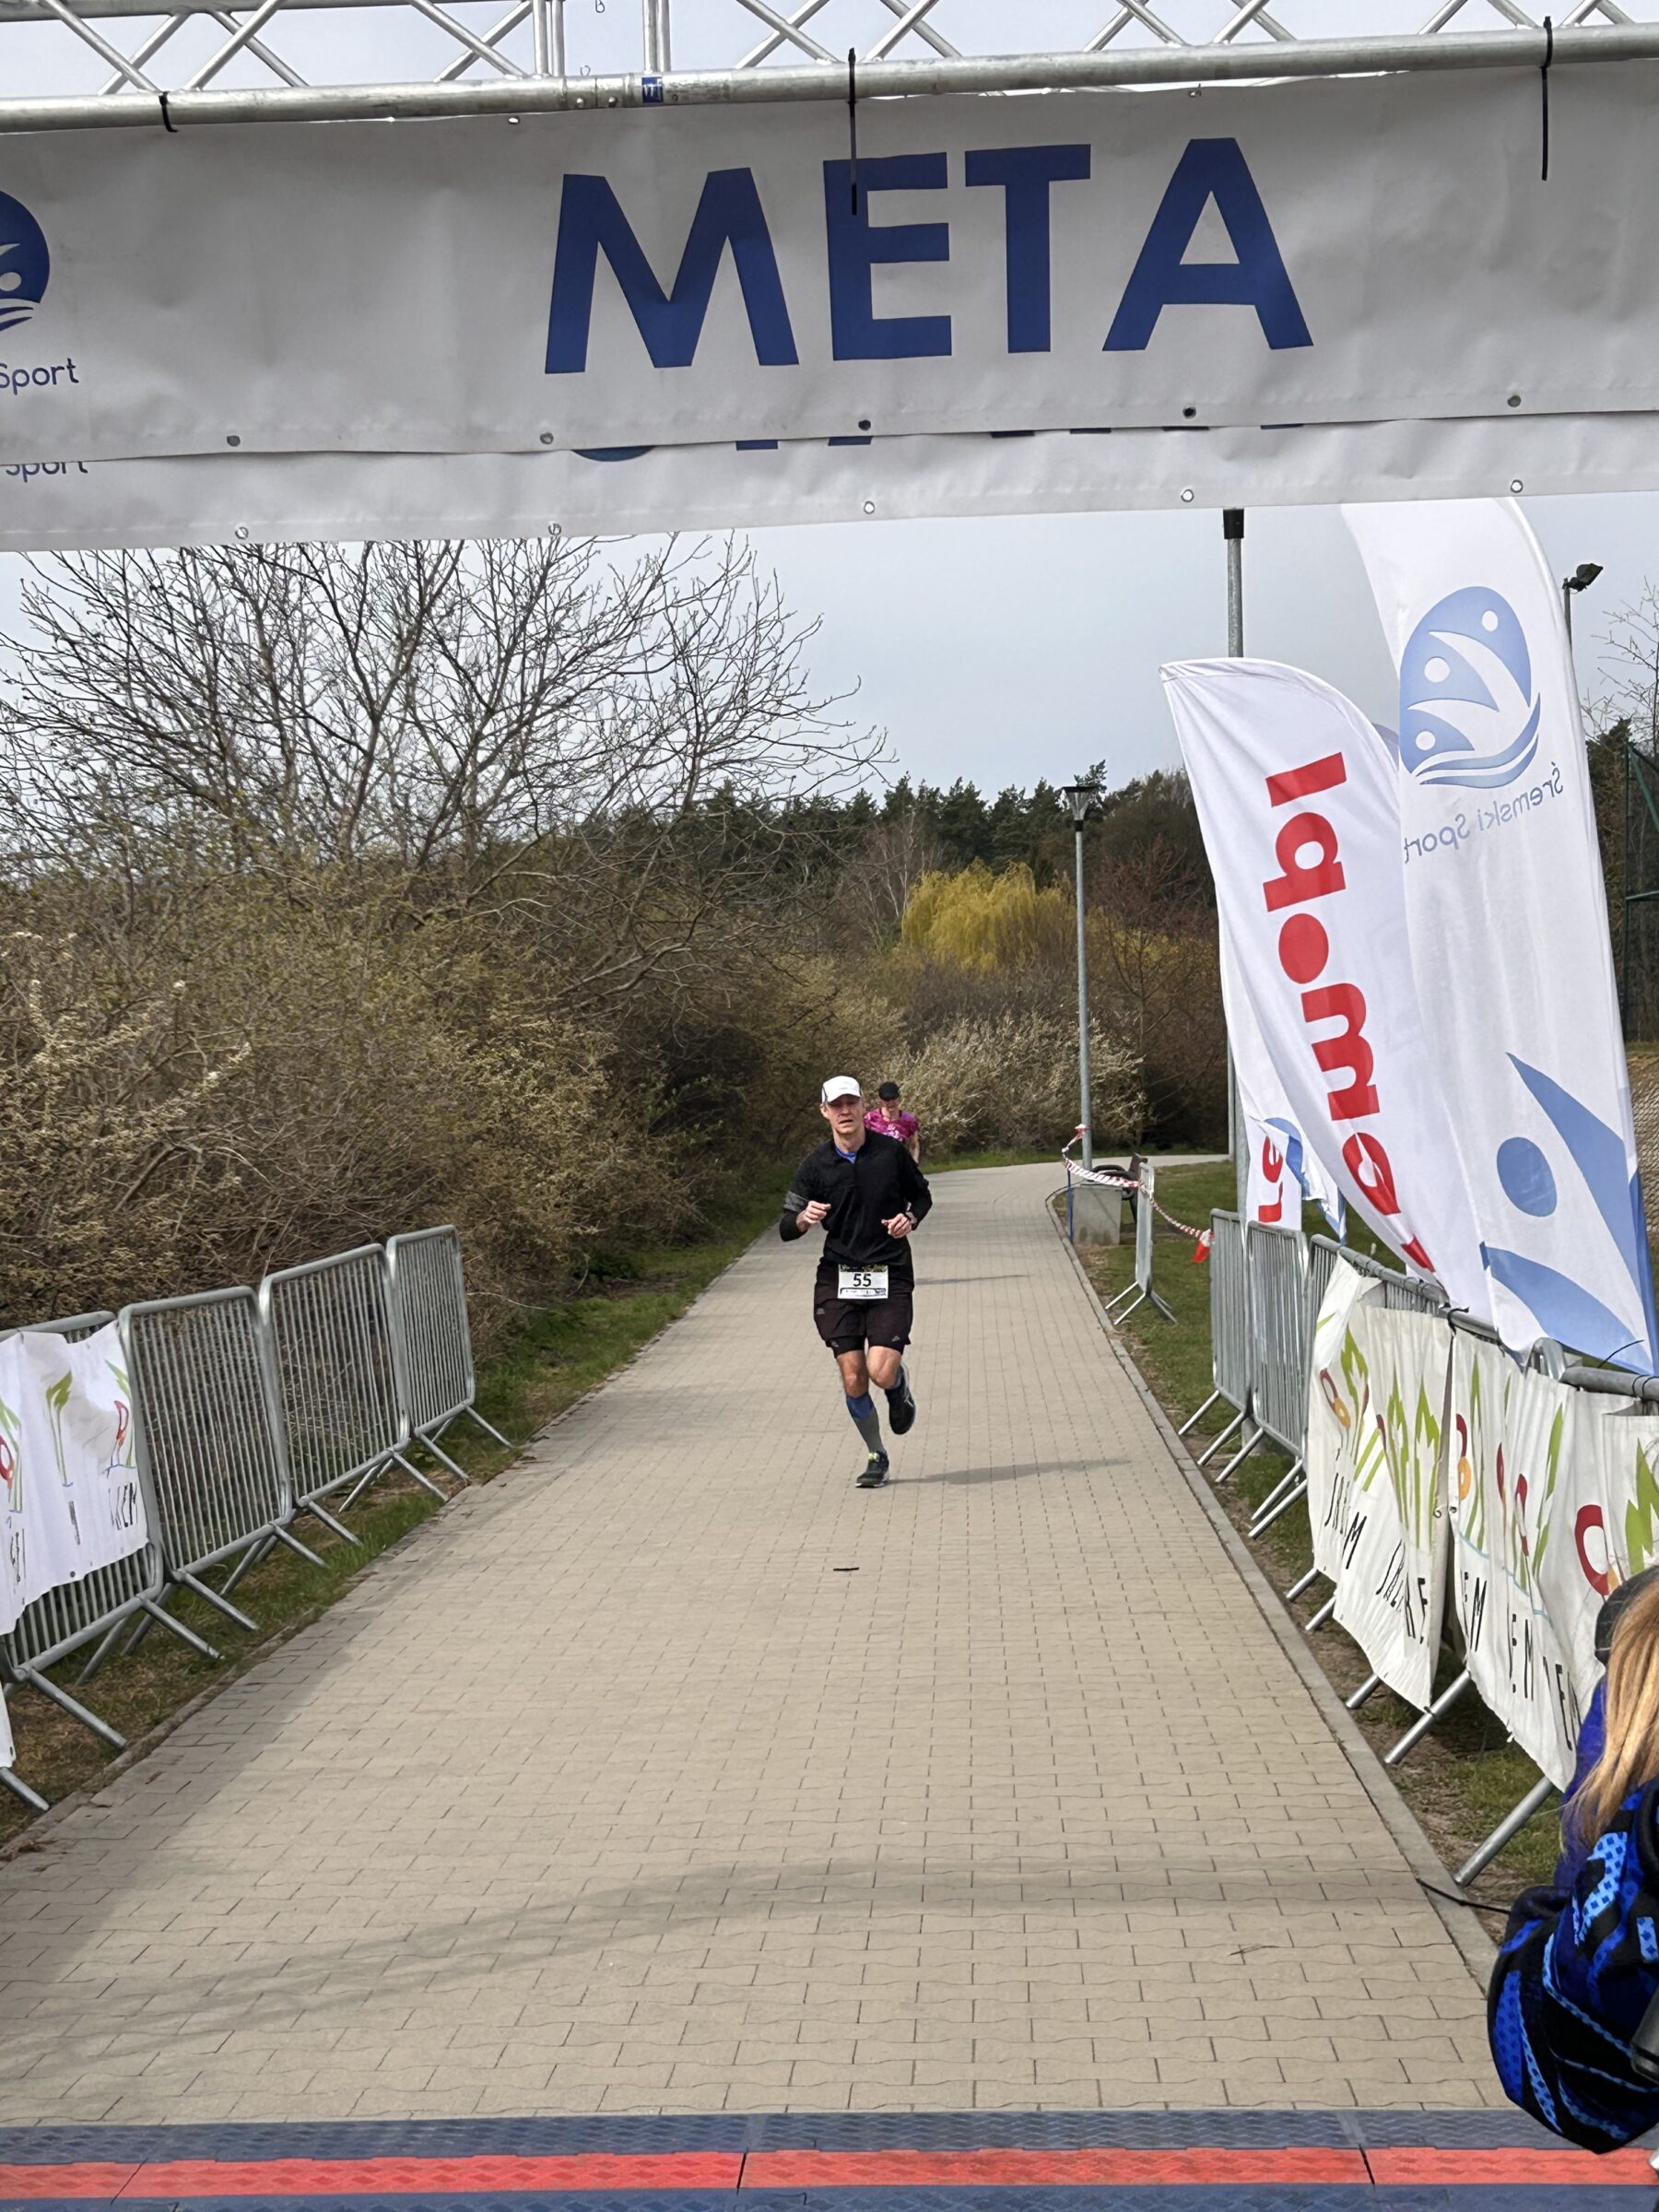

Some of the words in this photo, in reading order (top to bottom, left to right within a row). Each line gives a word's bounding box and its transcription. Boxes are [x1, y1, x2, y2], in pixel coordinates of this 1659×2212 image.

[545, 137, 1314, 374] META
[0, 358, 79, 395] Sport
[853, 1273, 872, 1287] 55
